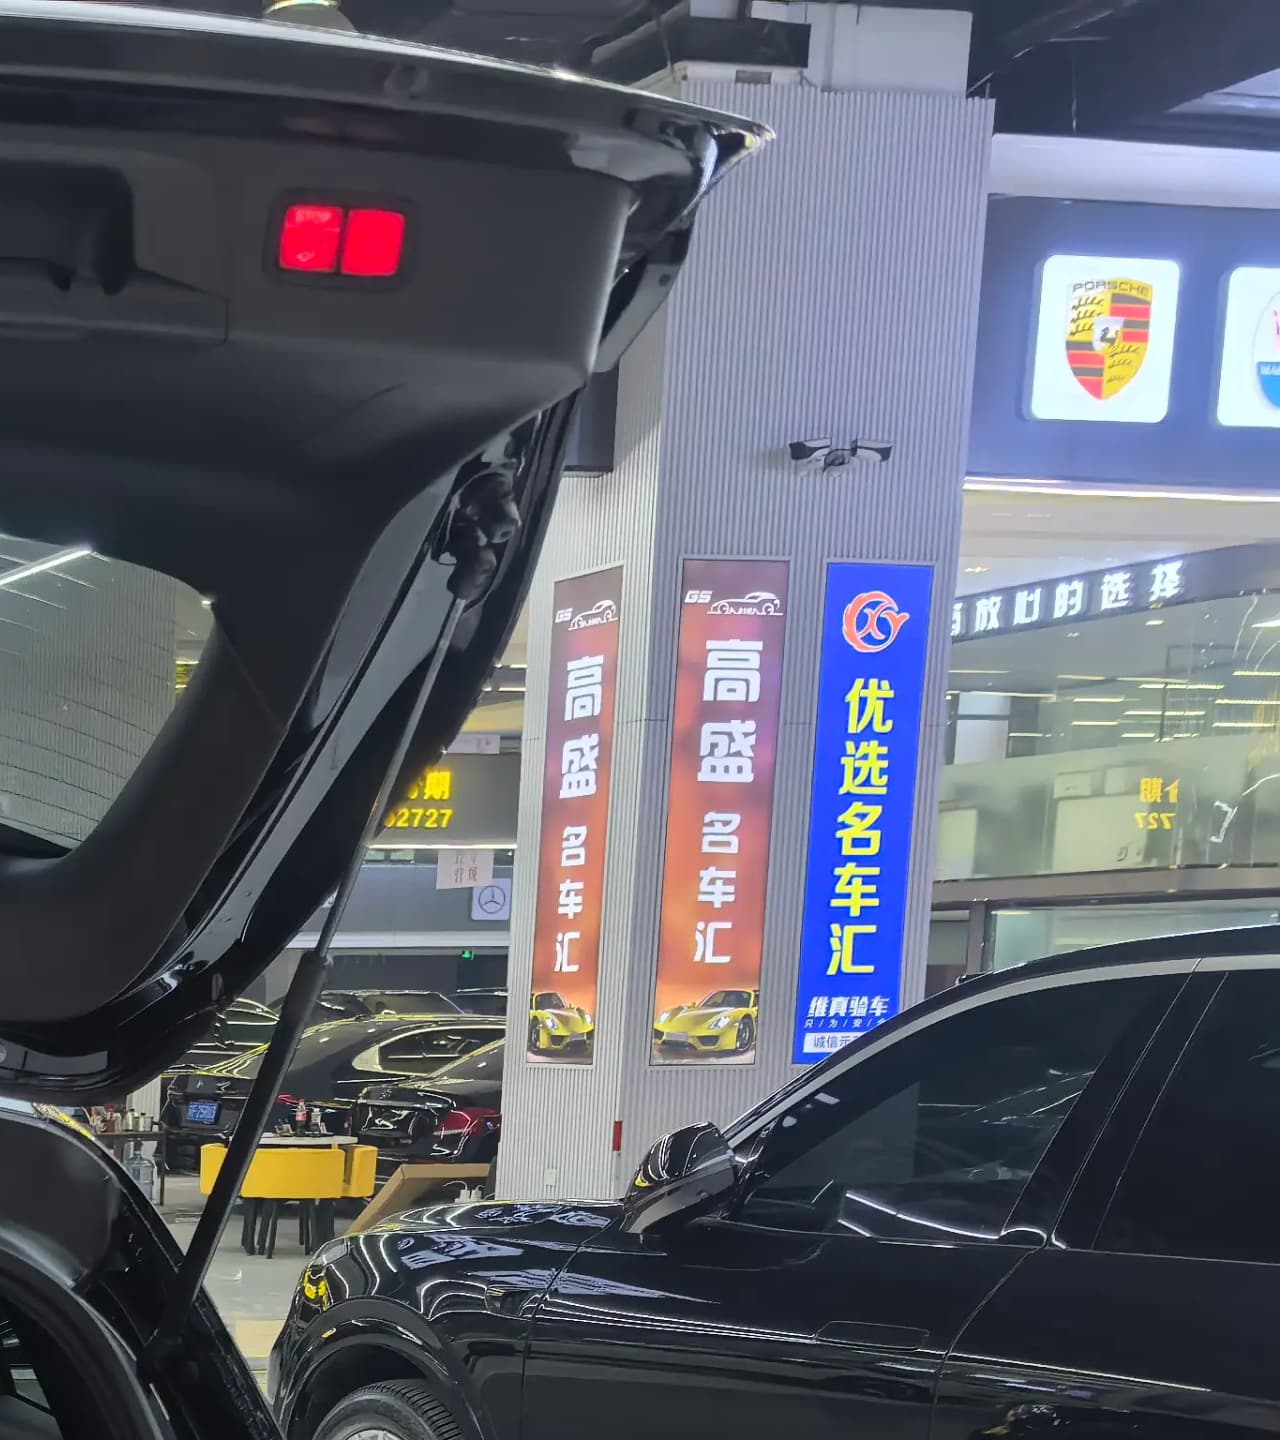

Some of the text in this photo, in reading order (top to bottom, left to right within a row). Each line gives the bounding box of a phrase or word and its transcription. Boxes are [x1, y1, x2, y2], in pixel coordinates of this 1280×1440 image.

[1072, 280, 1151, 297] PORSCHE
[554, 655, 605, 973] 高盛名车汇
[692, 638, 764, 963] 高盛名车汇
[825, 677, 895, 976] 优选名车汇
[807, 996, 891, 1017] 维真验车
[814, 1035, 858, 1049] 诚信示
